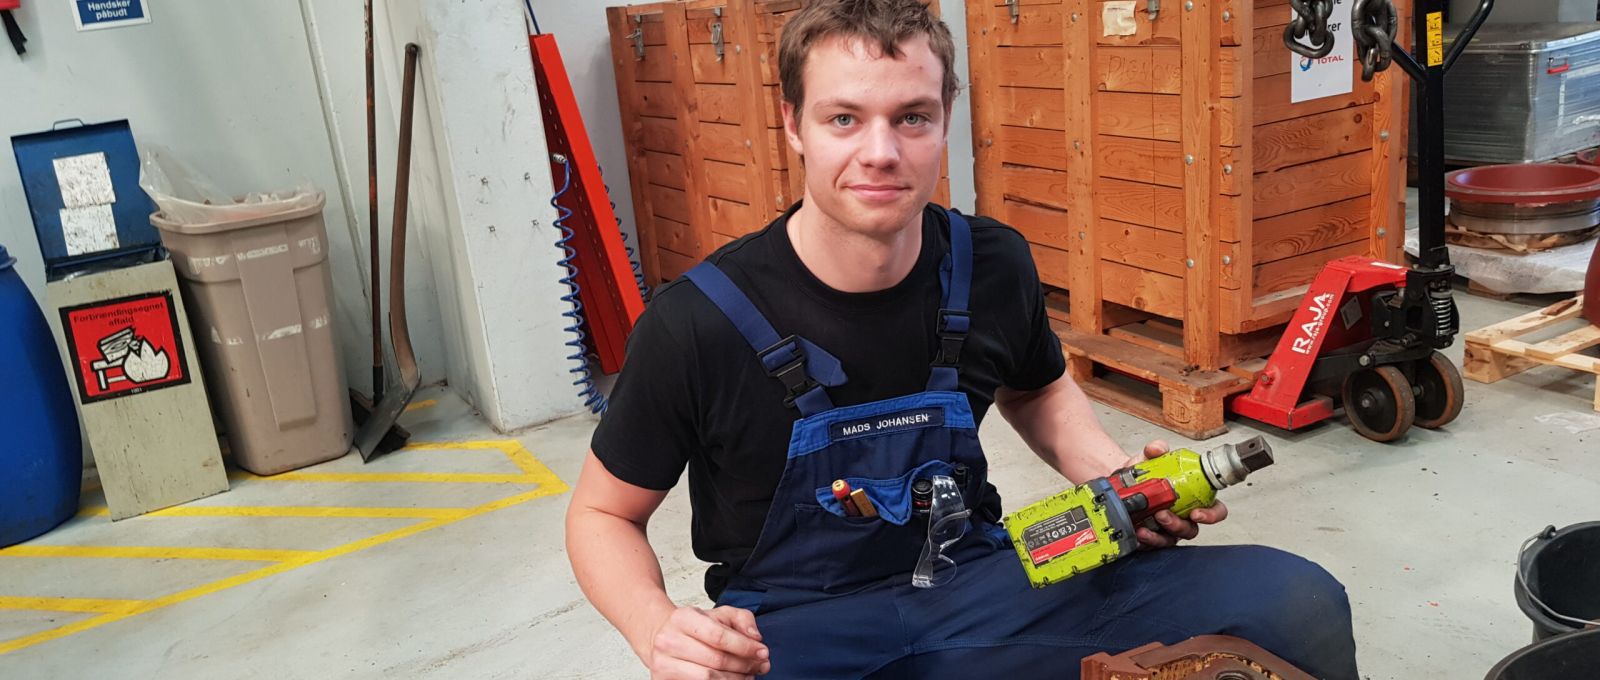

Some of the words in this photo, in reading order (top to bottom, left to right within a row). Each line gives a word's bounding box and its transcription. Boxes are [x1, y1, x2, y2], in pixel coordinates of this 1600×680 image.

[88, 0, 131, 11] Handsker
[96, 8, 127, 21] påbudt
[1317, 55, 1344, 64] TOTAL
[74, 302, 163, 323] Forbrændingsegnet
[109, 316, 134, 326] affald
[1291, 292, 1331, 354] RAJA
[842, 422, 871, 436] MADS
[876, 413, 930, 430] JOHANSEN
